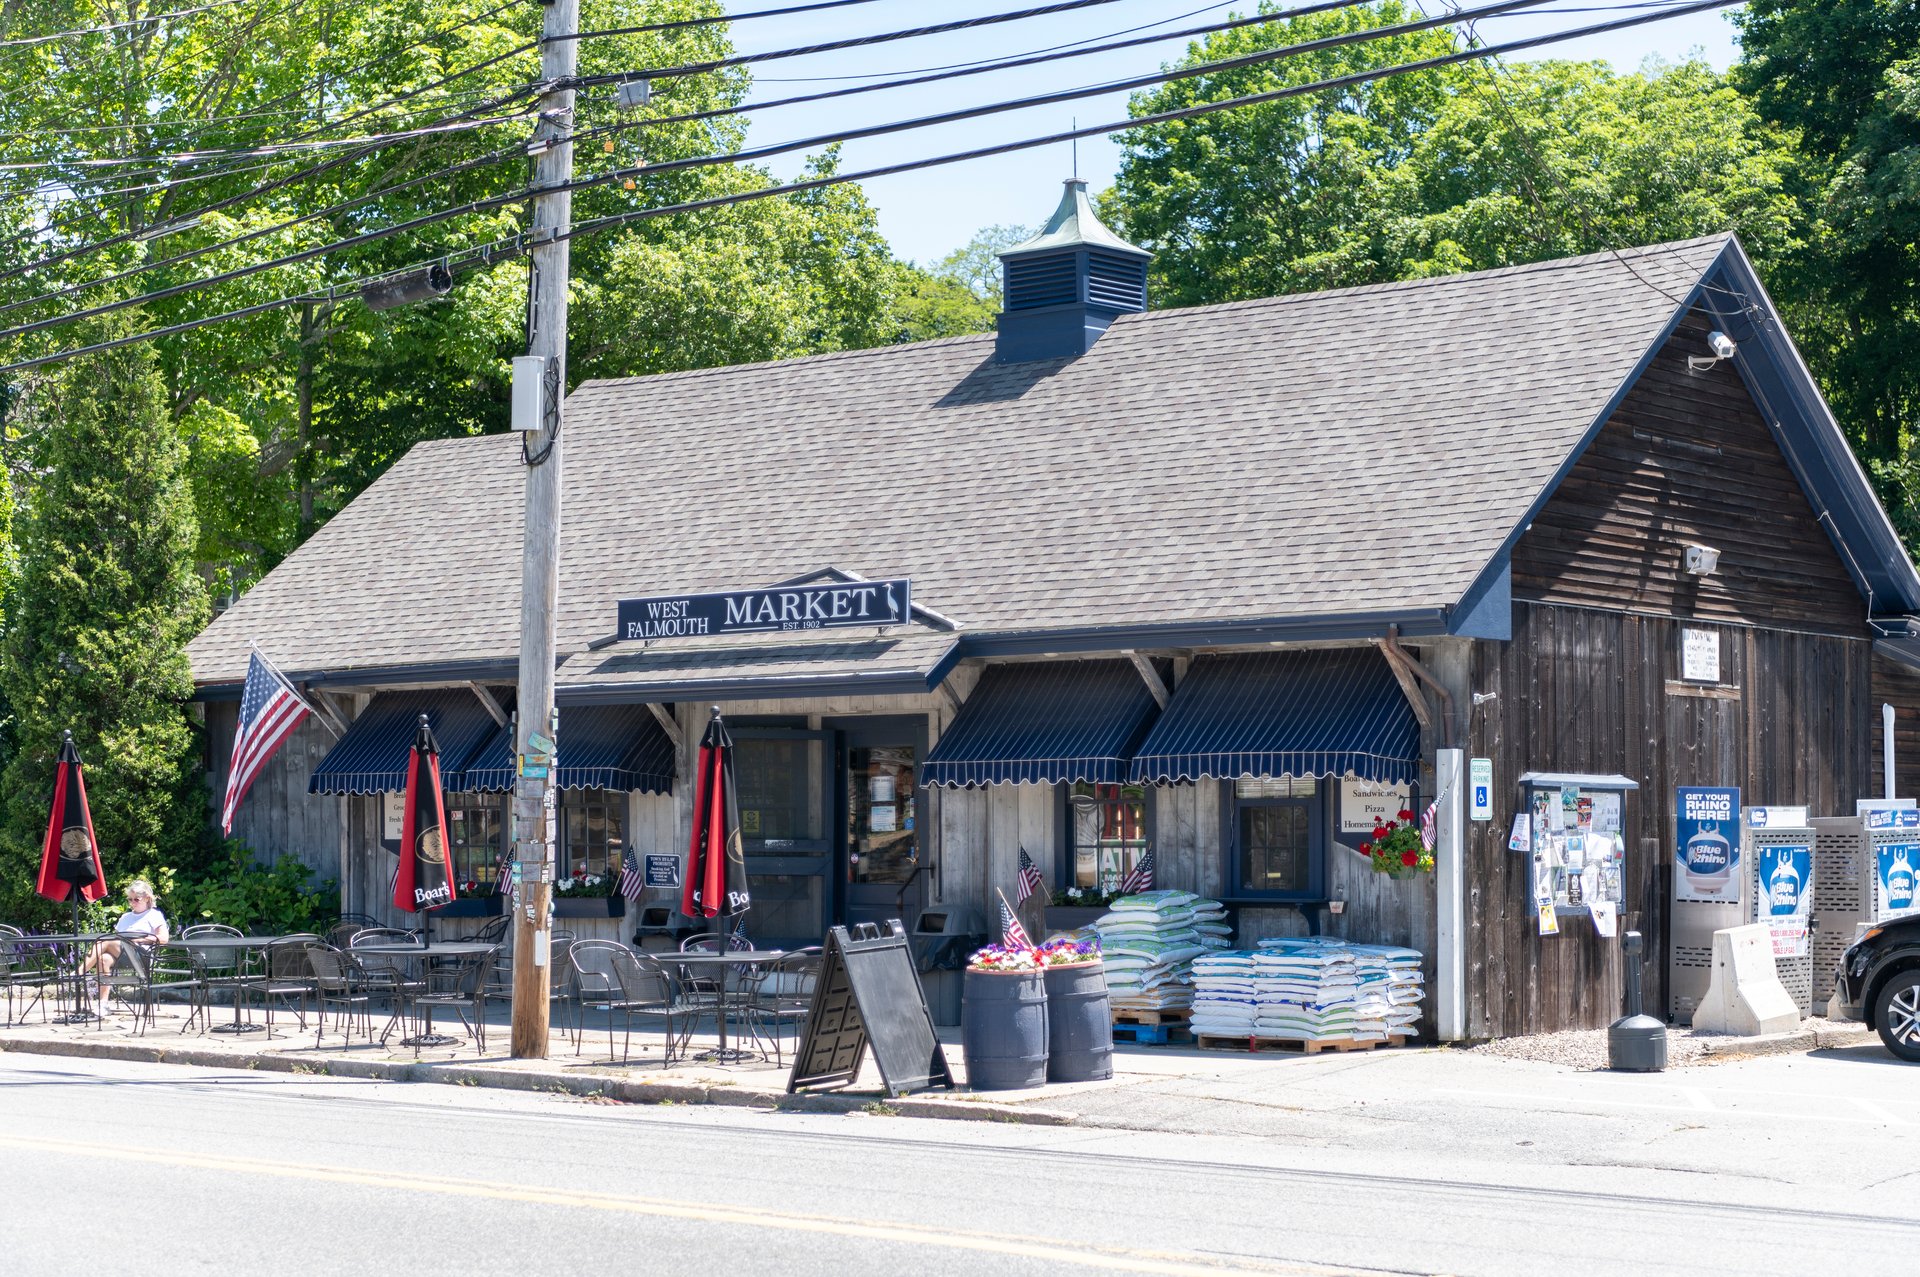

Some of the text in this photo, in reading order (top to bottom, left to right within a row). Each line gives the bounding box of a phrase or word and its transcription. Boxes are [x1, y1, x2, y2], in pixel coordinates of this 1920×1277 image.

[647, 600, 690, 618] WEST
[723, 587, 876, 625] MARKET
[627, 617, 709, 639] FALMOUTH
[782, 620, 821, 631] EST. 1902
[1472, 765, 1490, 773] RESERVED
[1686, 801, 1730, 810] RHINO
[1686, 810, 1730, 820] HERE!
[1696, 845, 1721, 854] Blue
[1694, 854, 1726, 864] Rhino
[1776, 882, 1794, 893] Blue
[1893, 877, 1909, 888] Blue
[414, 881, 450, 904] Boar's
[1892, 888, 1911, 900] Rhino
[1774, 893, 1796, 906] Rhino
